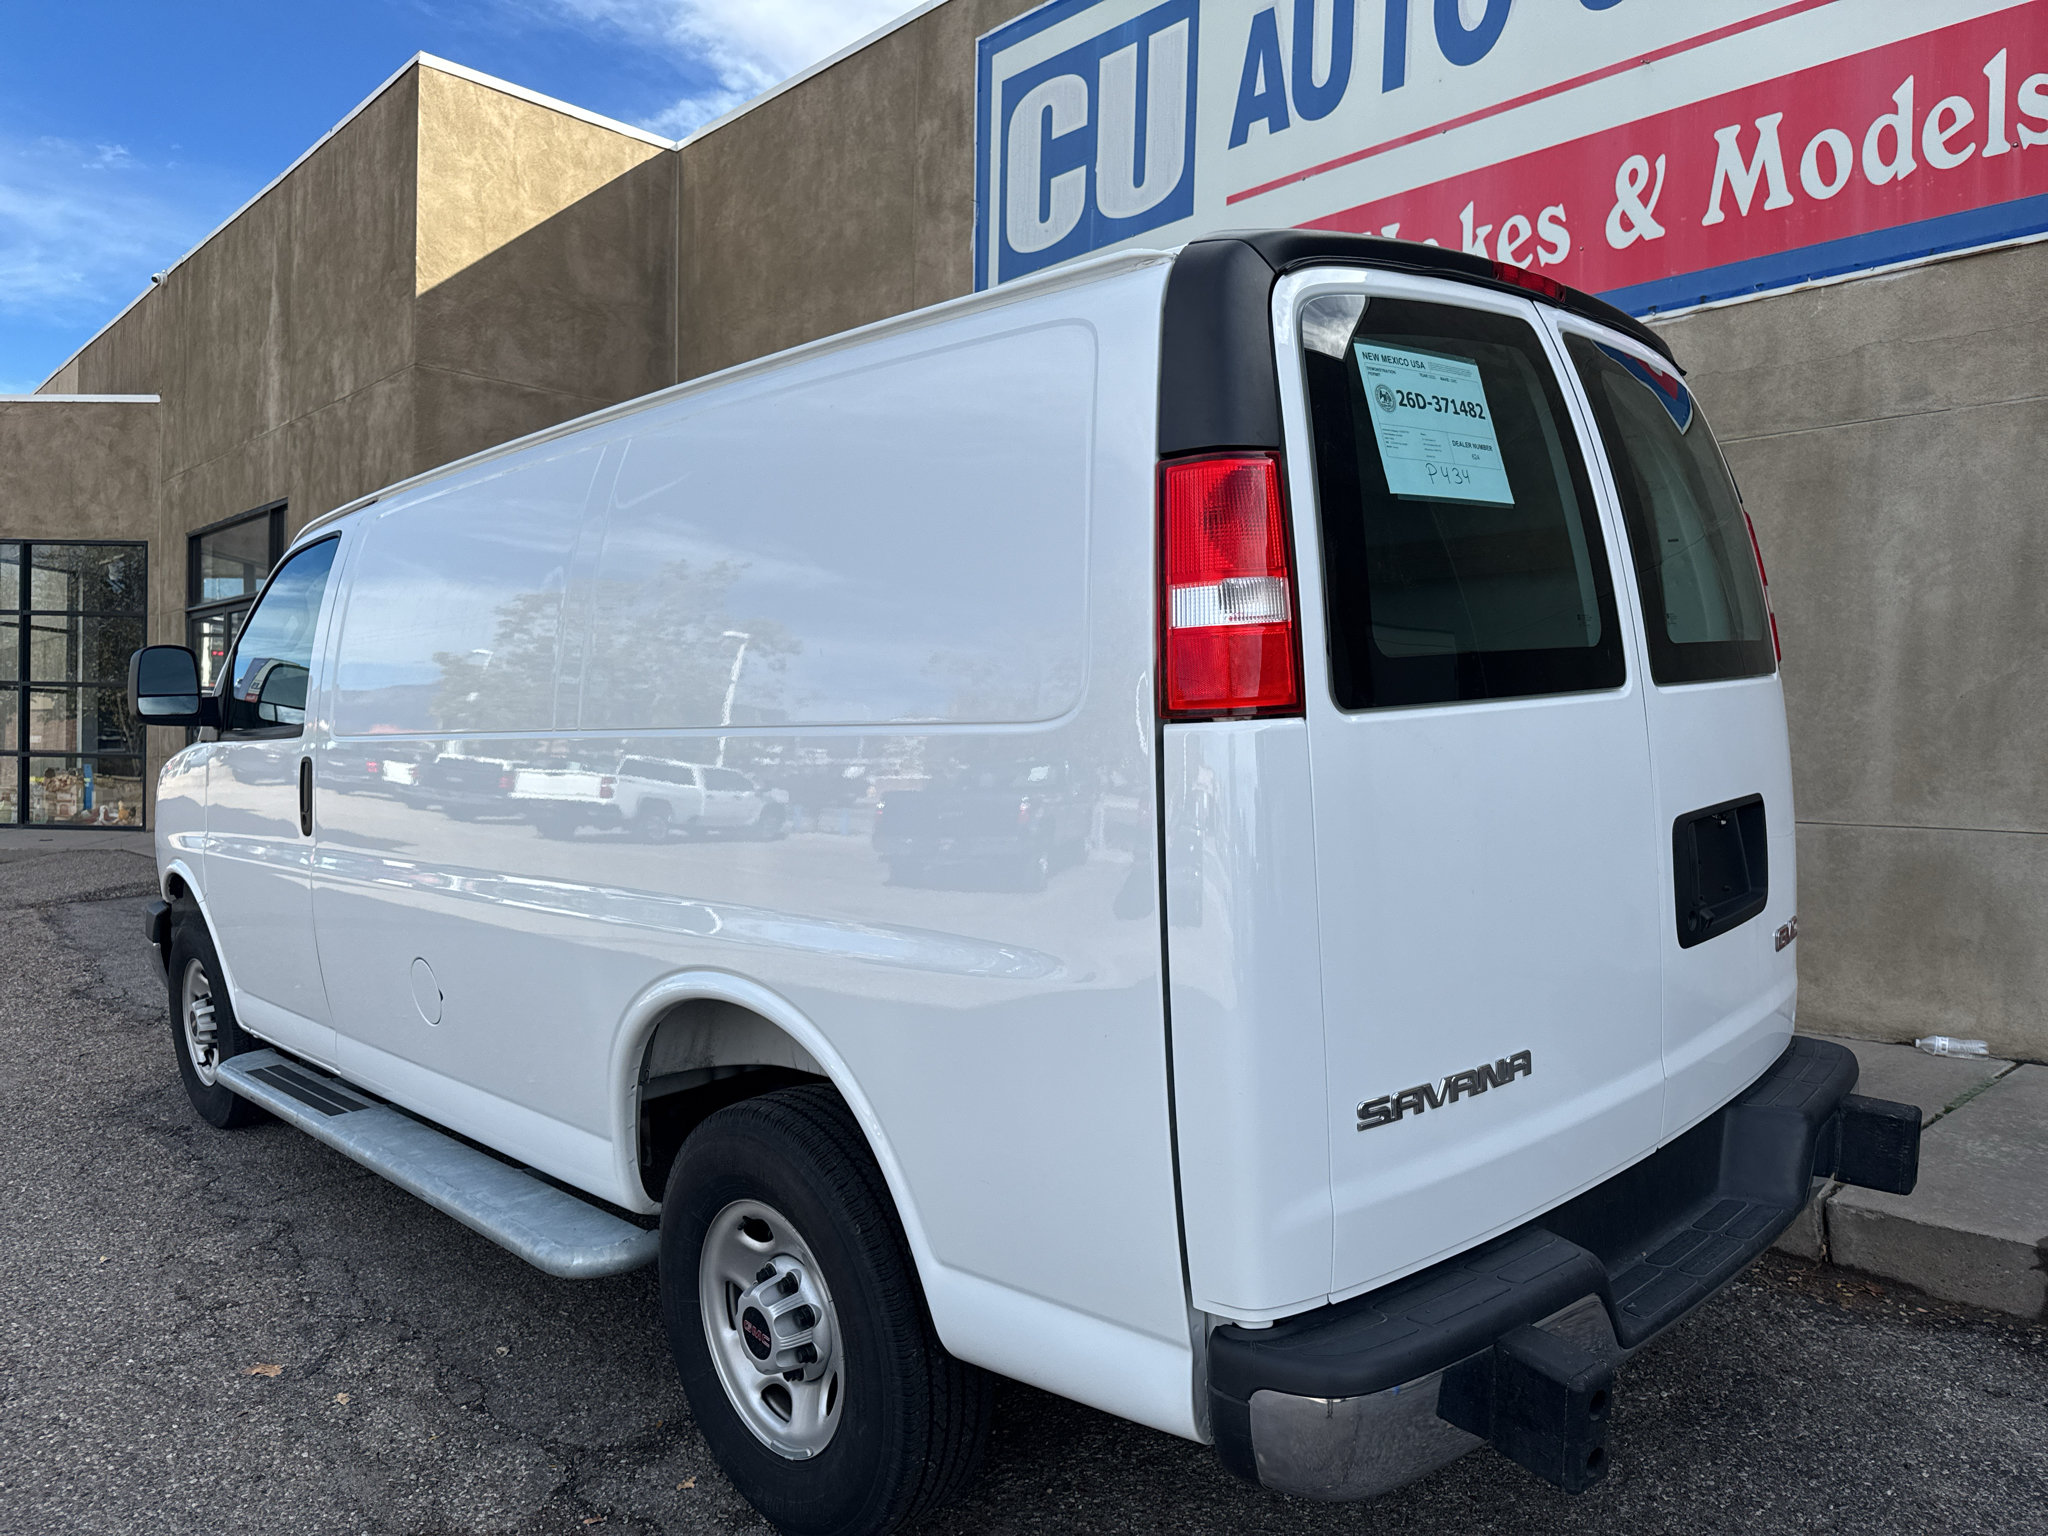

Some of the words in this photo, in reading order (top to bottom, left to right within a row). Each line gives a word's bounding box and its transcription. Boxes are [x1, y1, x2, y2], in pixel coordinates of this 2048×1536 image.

[1006, 17, 1189, 253] CU
[1364, 200, 1571, 269] kes
[1605, 153, 1666, 250] &
[1701, 47, 2048, 226] Models
[1361, 351, 1380, 362] NEW
[1381, 354, 1409, 367] MEXICO
[1410, 359, 1426, 370] USA
[1396, 389, 1486, 420] 26D-371482
[1451, 440, 1472, 449] DEALER
[1472, 443, 1493, 451] NUMBER
[1425, 462, 1471, 485] P434
[1356, 1049, 1533, 1132] SAVANA
[743, 1319, 770, 1348] GMC
